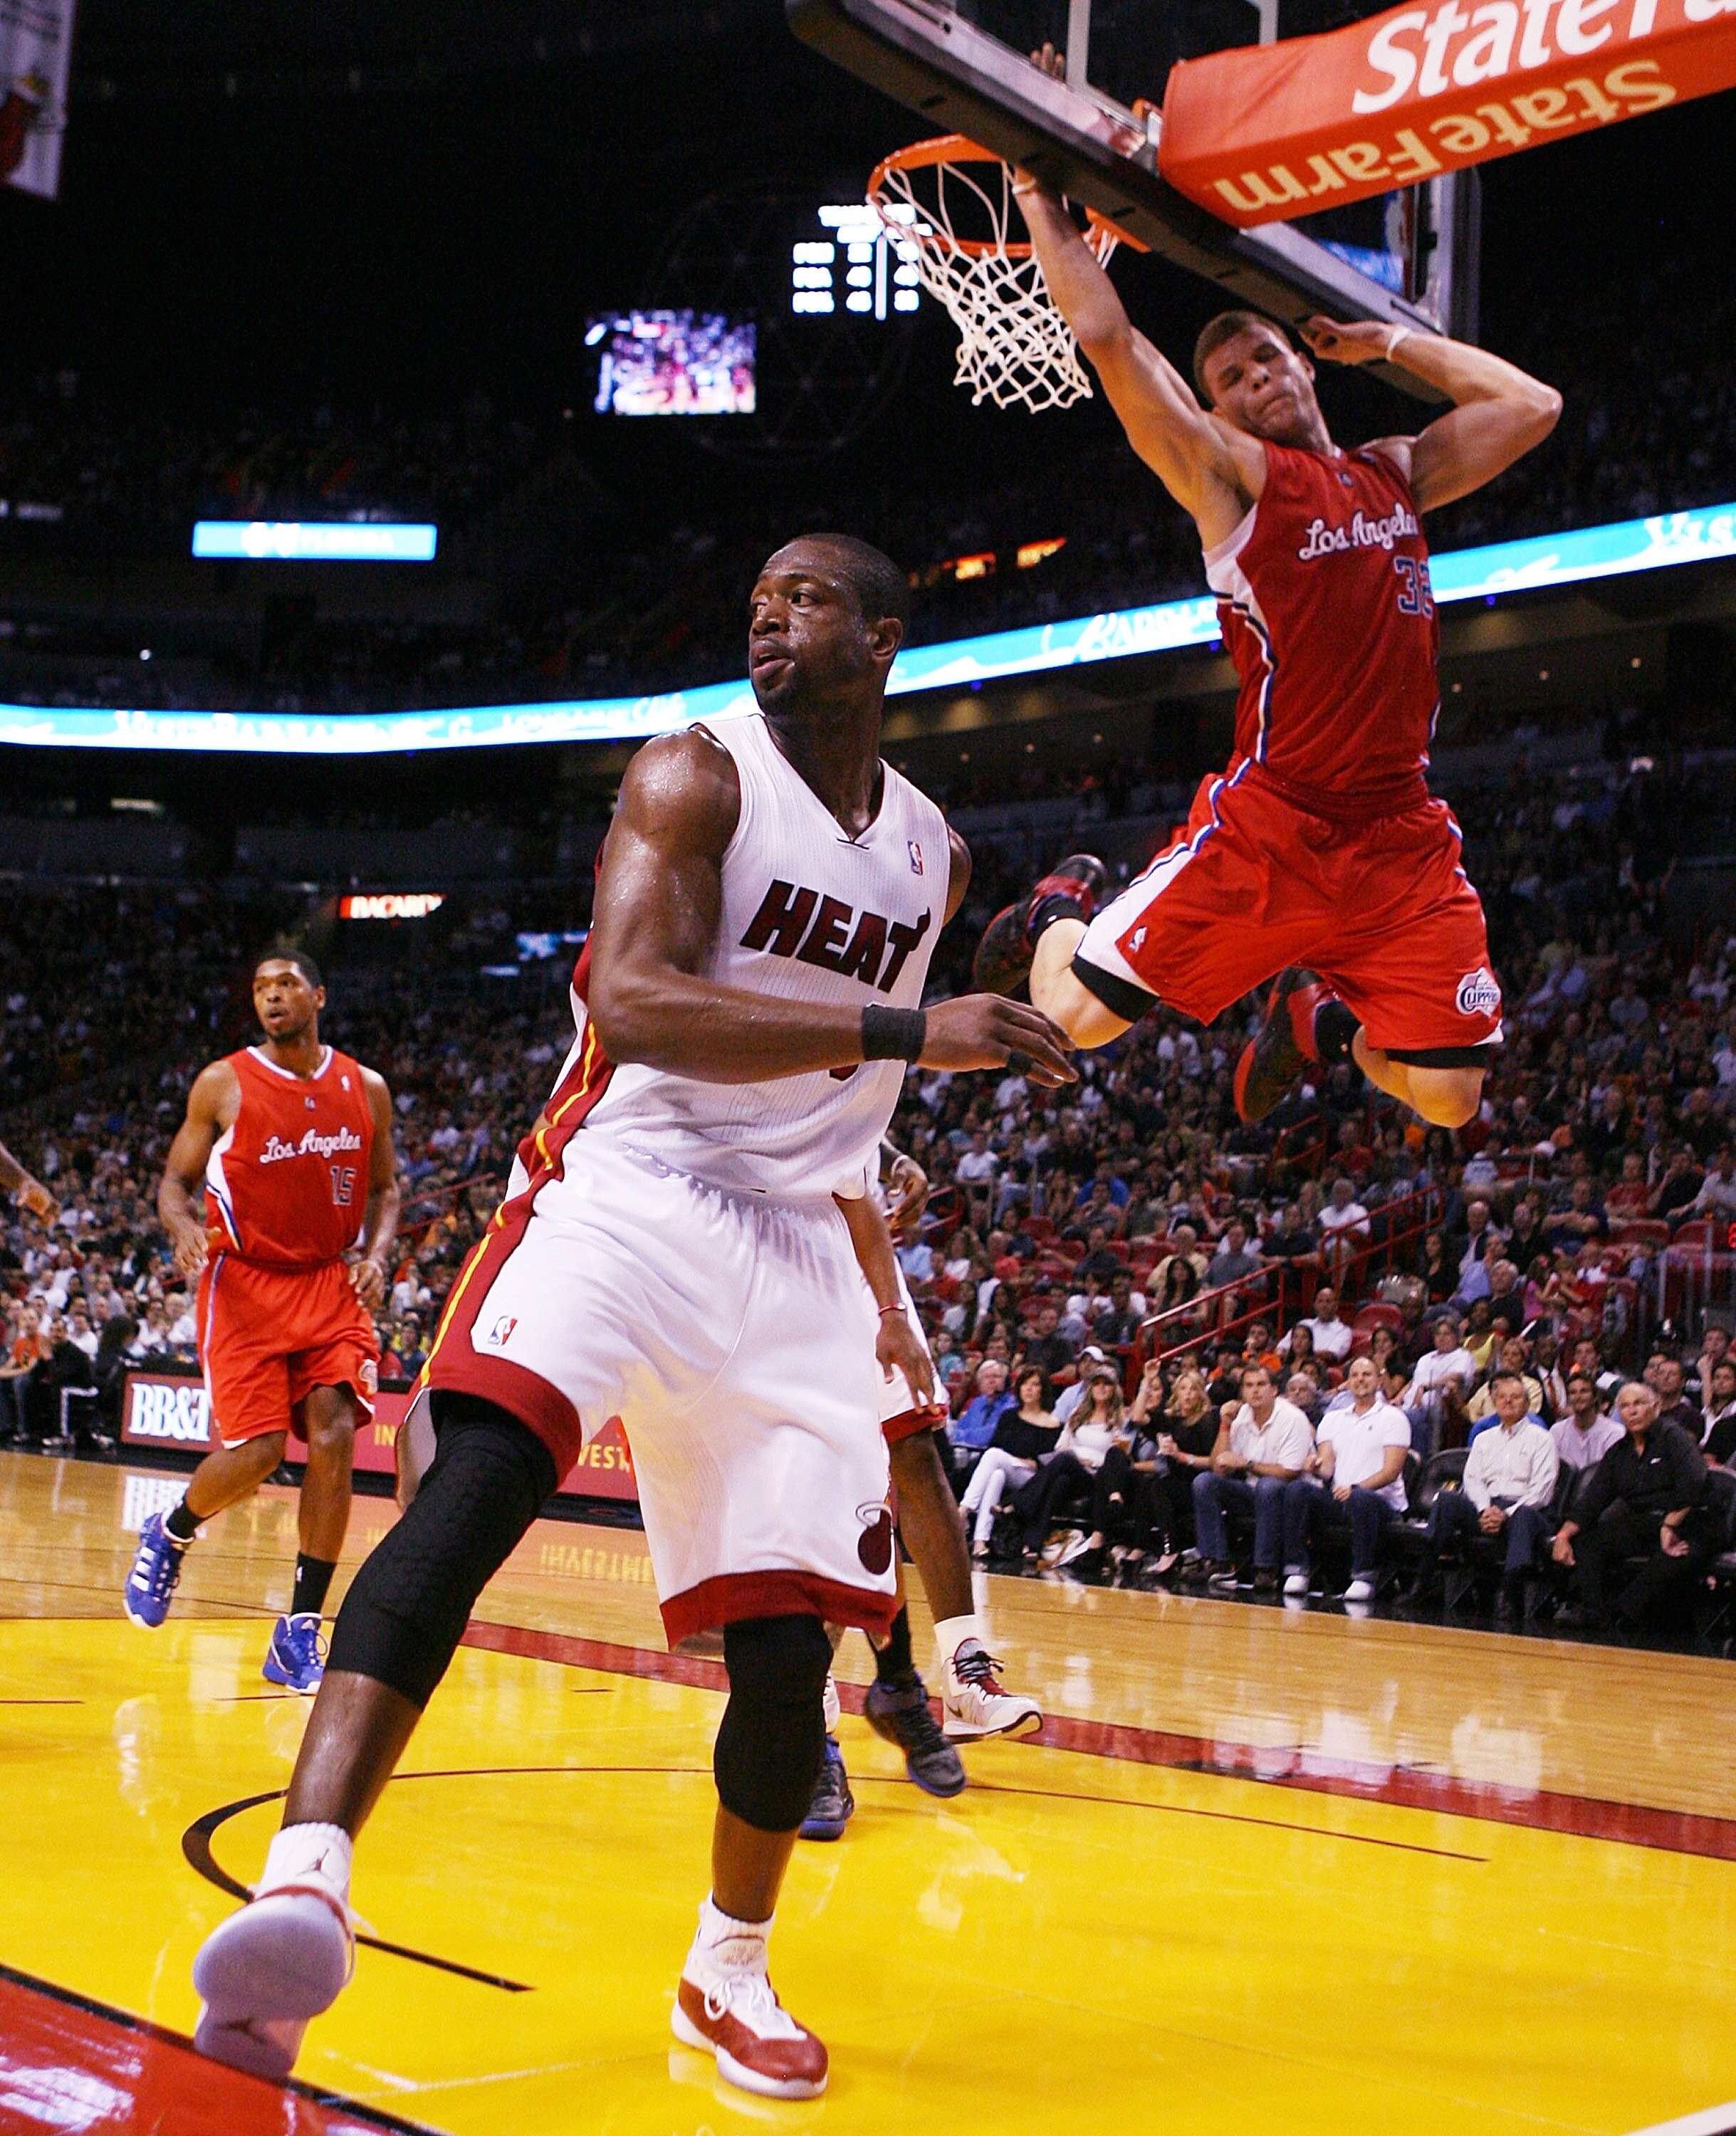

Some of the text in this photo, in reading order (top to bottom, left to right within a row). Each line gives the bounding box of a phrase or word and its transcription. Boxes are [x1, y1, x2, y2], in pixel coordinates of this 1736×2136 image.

[1298, 518, 1351, 561] Los
[739, 879, 931, 995] HEAT
[259, 1126, 362, 1164] Los Angeles
[330, 1166, 356, 1205] 15
[128, 1382, 211, 1443] BB&T
